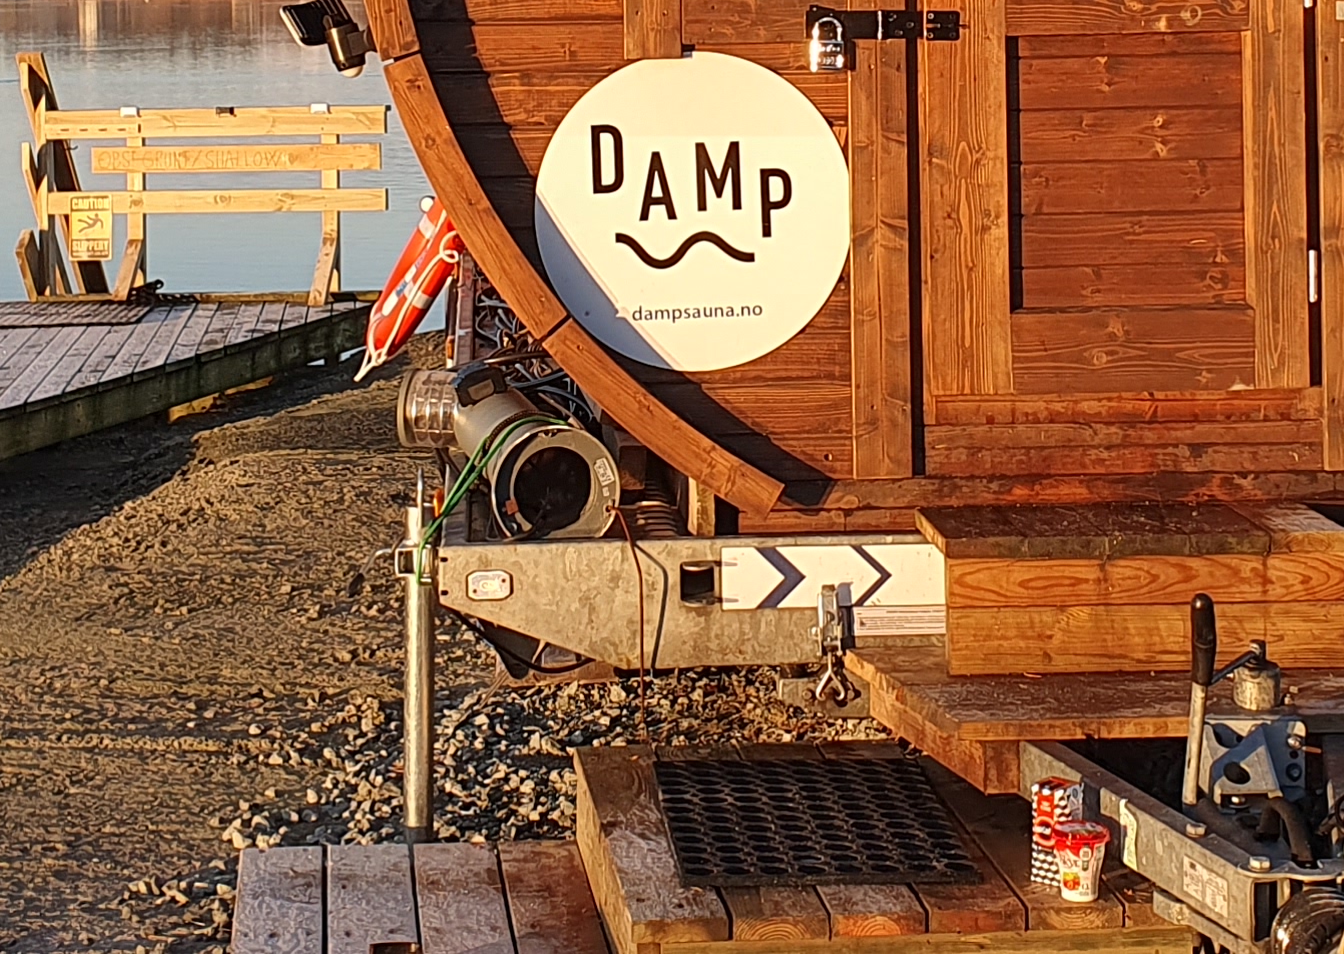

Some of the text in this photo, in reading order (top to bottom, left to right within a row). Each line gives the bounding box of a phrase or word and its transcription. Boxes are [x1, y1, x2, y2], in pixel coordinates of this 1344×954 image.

[590, 124, 793, 239] DAMP
[72, 198, 110, 210] CAUTION
[72, 240, 109, 252] SLIPPERY
[631, 304, 764, 324] dampsauna.no
